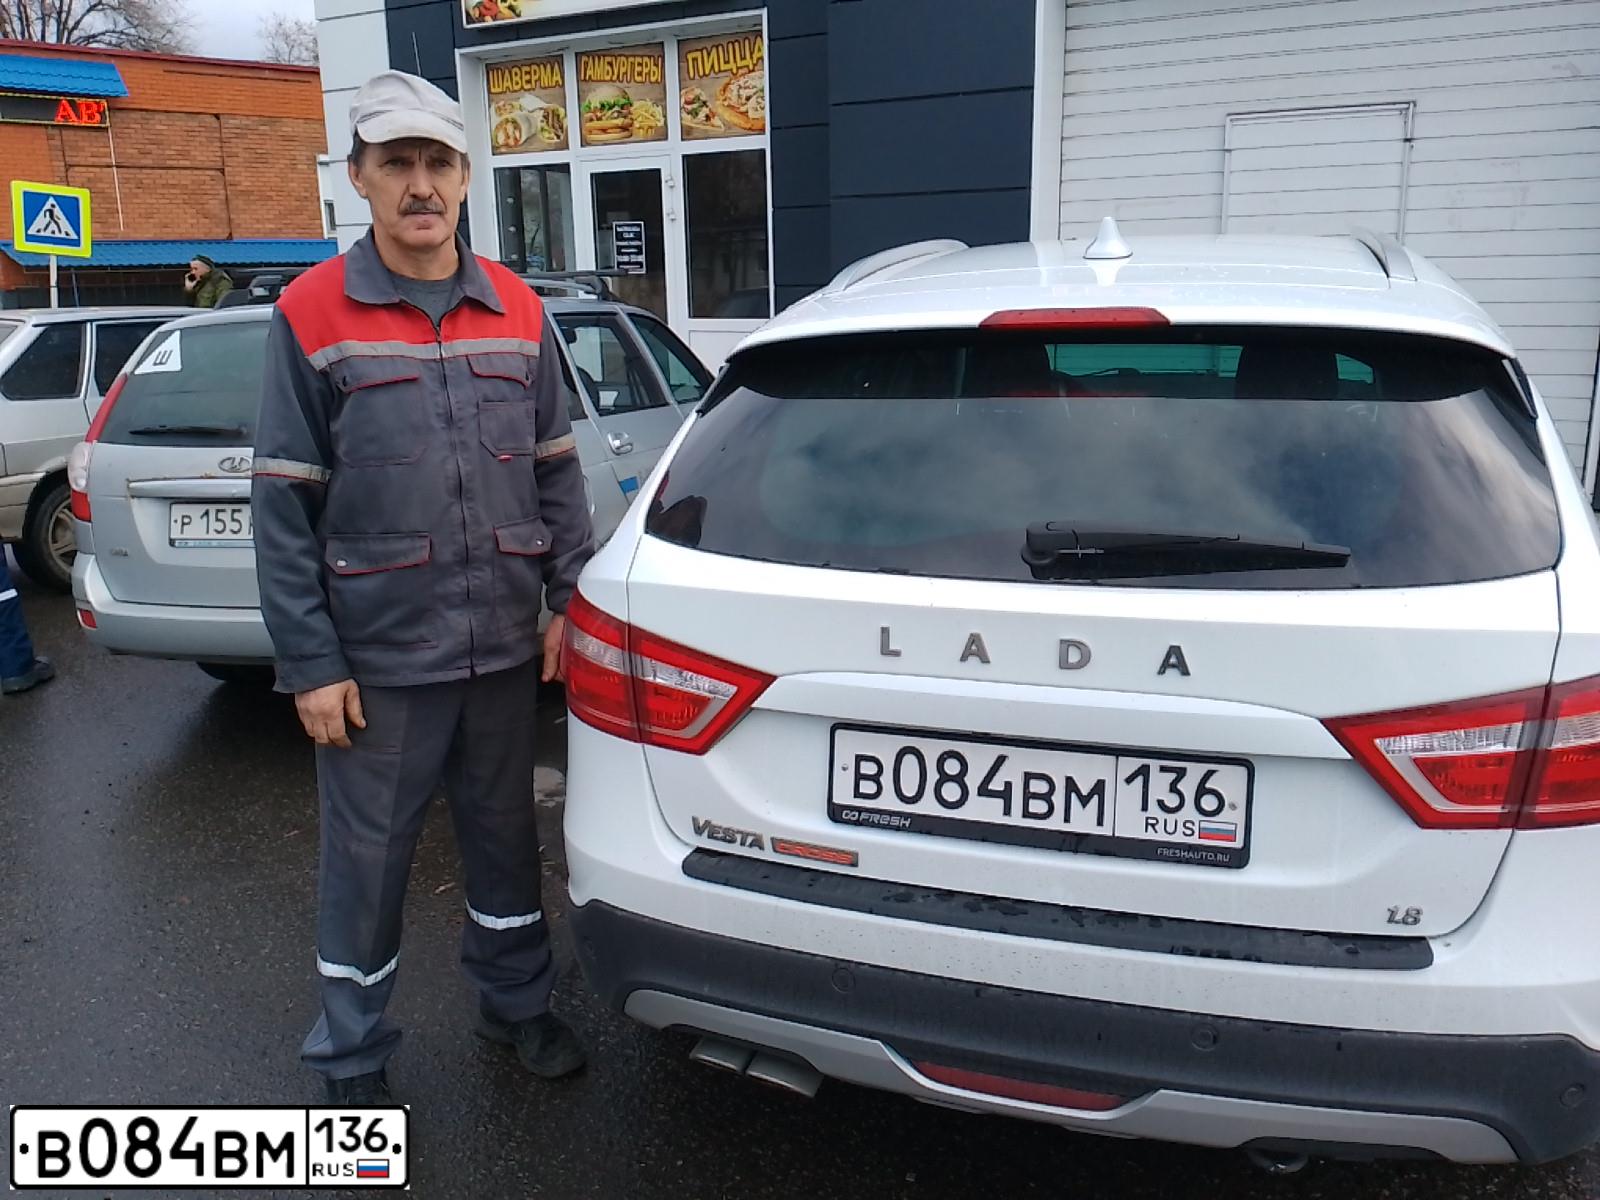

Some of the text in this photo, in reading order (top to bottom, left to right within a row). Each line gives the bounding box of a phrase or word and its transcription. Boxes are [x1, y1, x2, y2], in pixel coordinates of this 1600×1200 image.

[580, 54, 663, 84] ГАМБУРГЕРЫ
[686, 34, 764, 80] ПИЦЦА
[488, 61, 563, 94] ШАВЕРМА
[880, 626, 1191, 677] LADA
[853, 745, 1106, 827] В084ВМ
[1124, 763, 1226, 818] 136
[692, 815, 765, 851] VESTA
[1144, 816, 1196, 837] RUS
[1157, 847, 1230, 862] FRESHAUTO.RU
